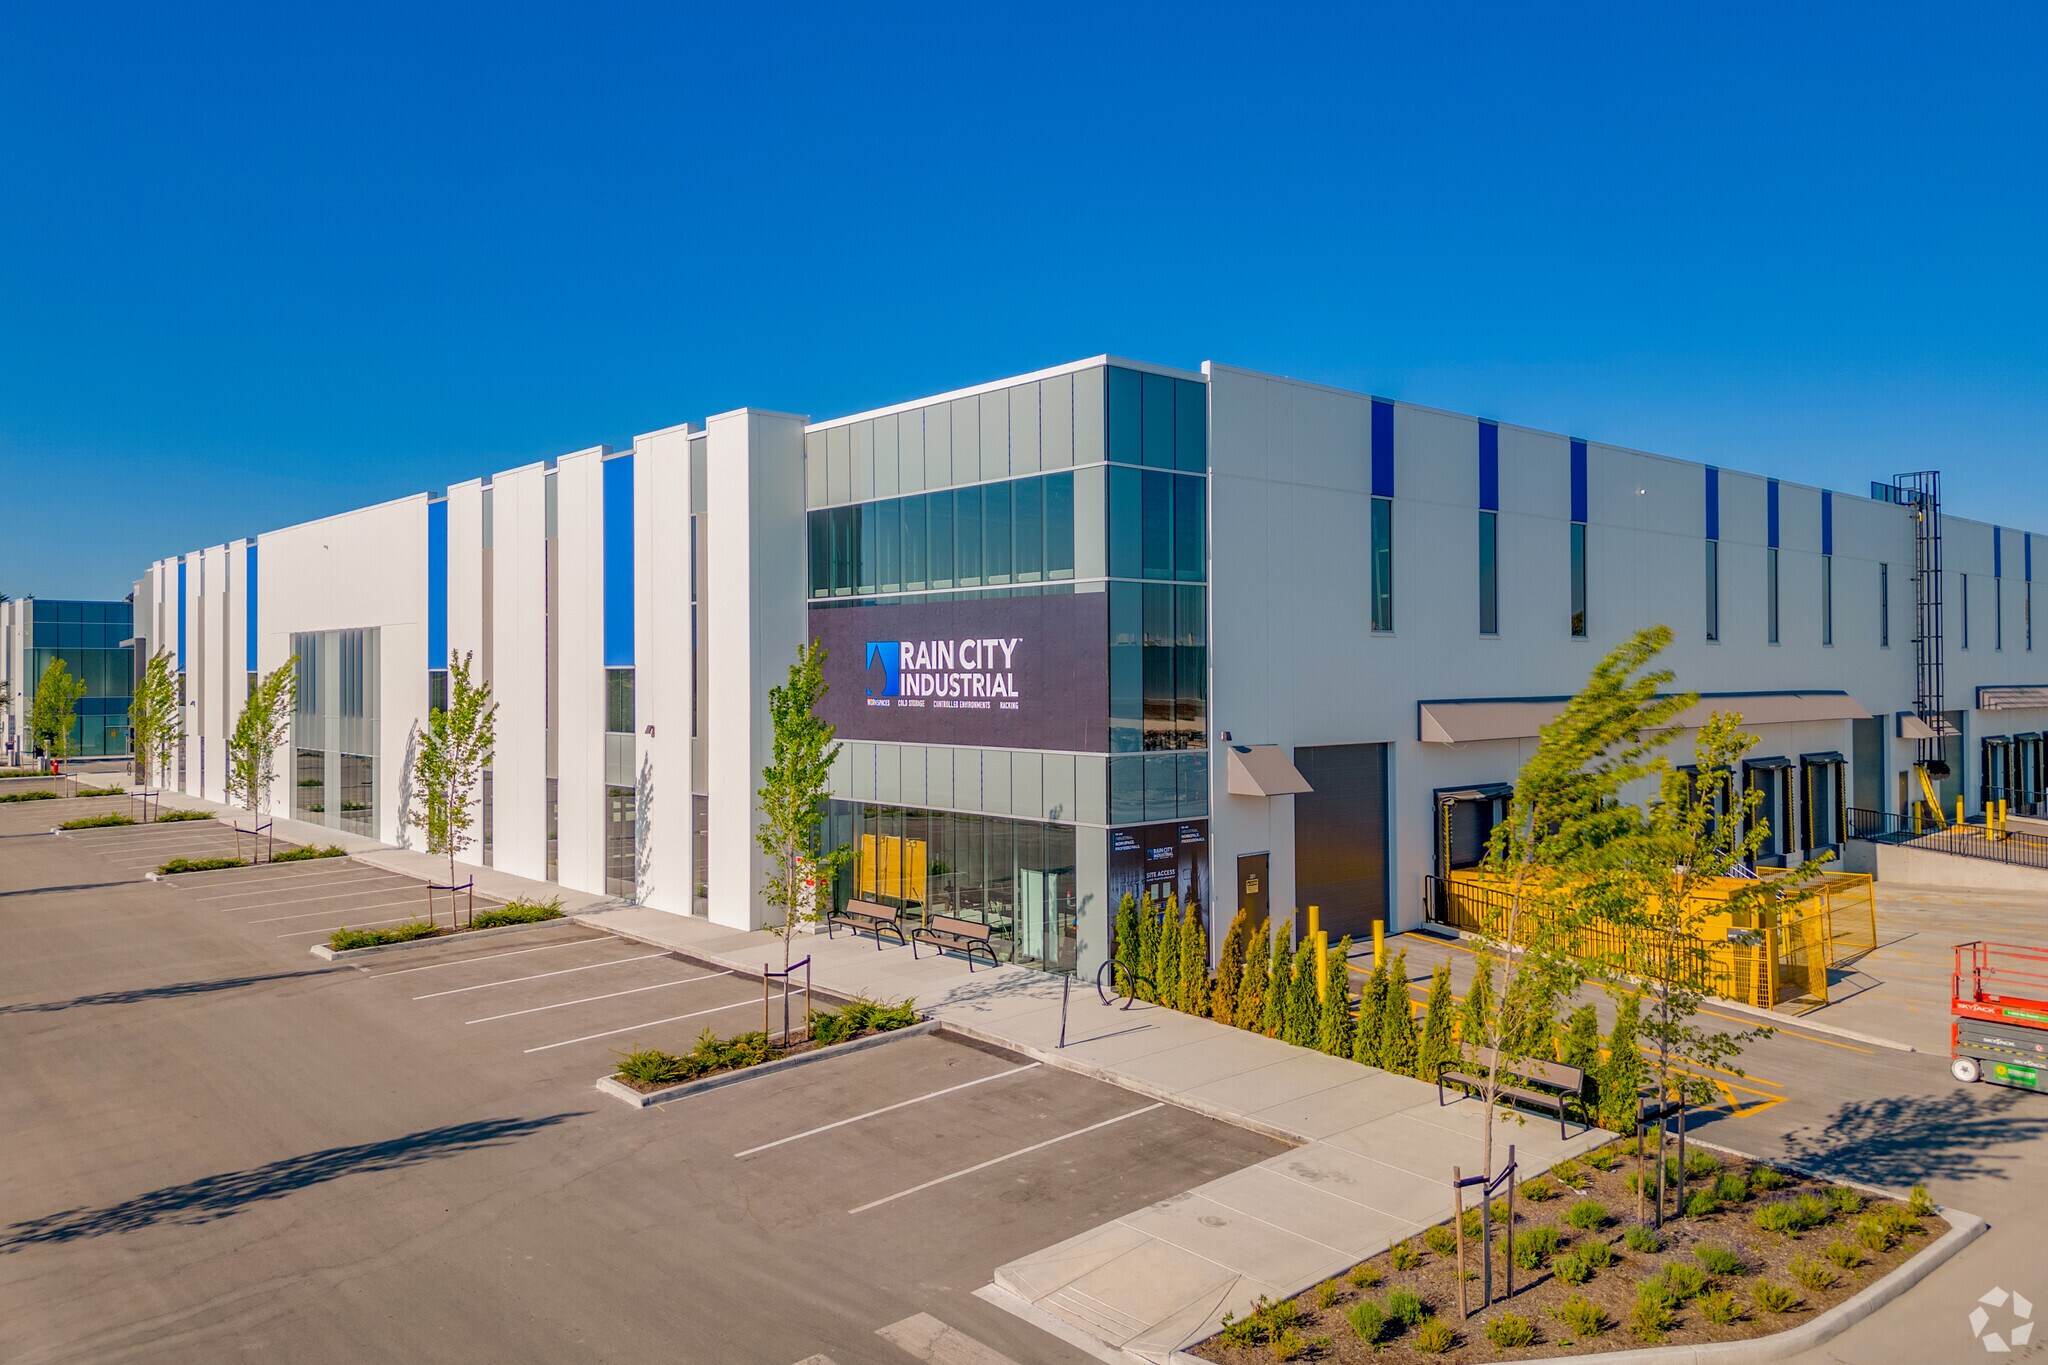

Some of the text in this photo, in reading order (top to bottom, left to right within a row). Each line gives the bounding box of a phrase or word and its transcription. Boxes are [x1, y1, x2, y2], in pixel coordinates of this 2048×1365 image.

[901, 638, 1018, 670] RAIN CITY
[900, 672, 1019, 697] INDUSTRIAL
[933, 700, 959, 708] CONTROLLED
[959, 700, 991, 709] ENVIRONMENTS
[1000, 701, 1019, 710] RACKING
[1146, 871, 1157, 879] SITE
[1157, 869, 1176, 877] ACCESS
[1956, 1003, 1995, 1014] SKYJACK
[1983, 1037, 2015, 1047] SKYJACK
